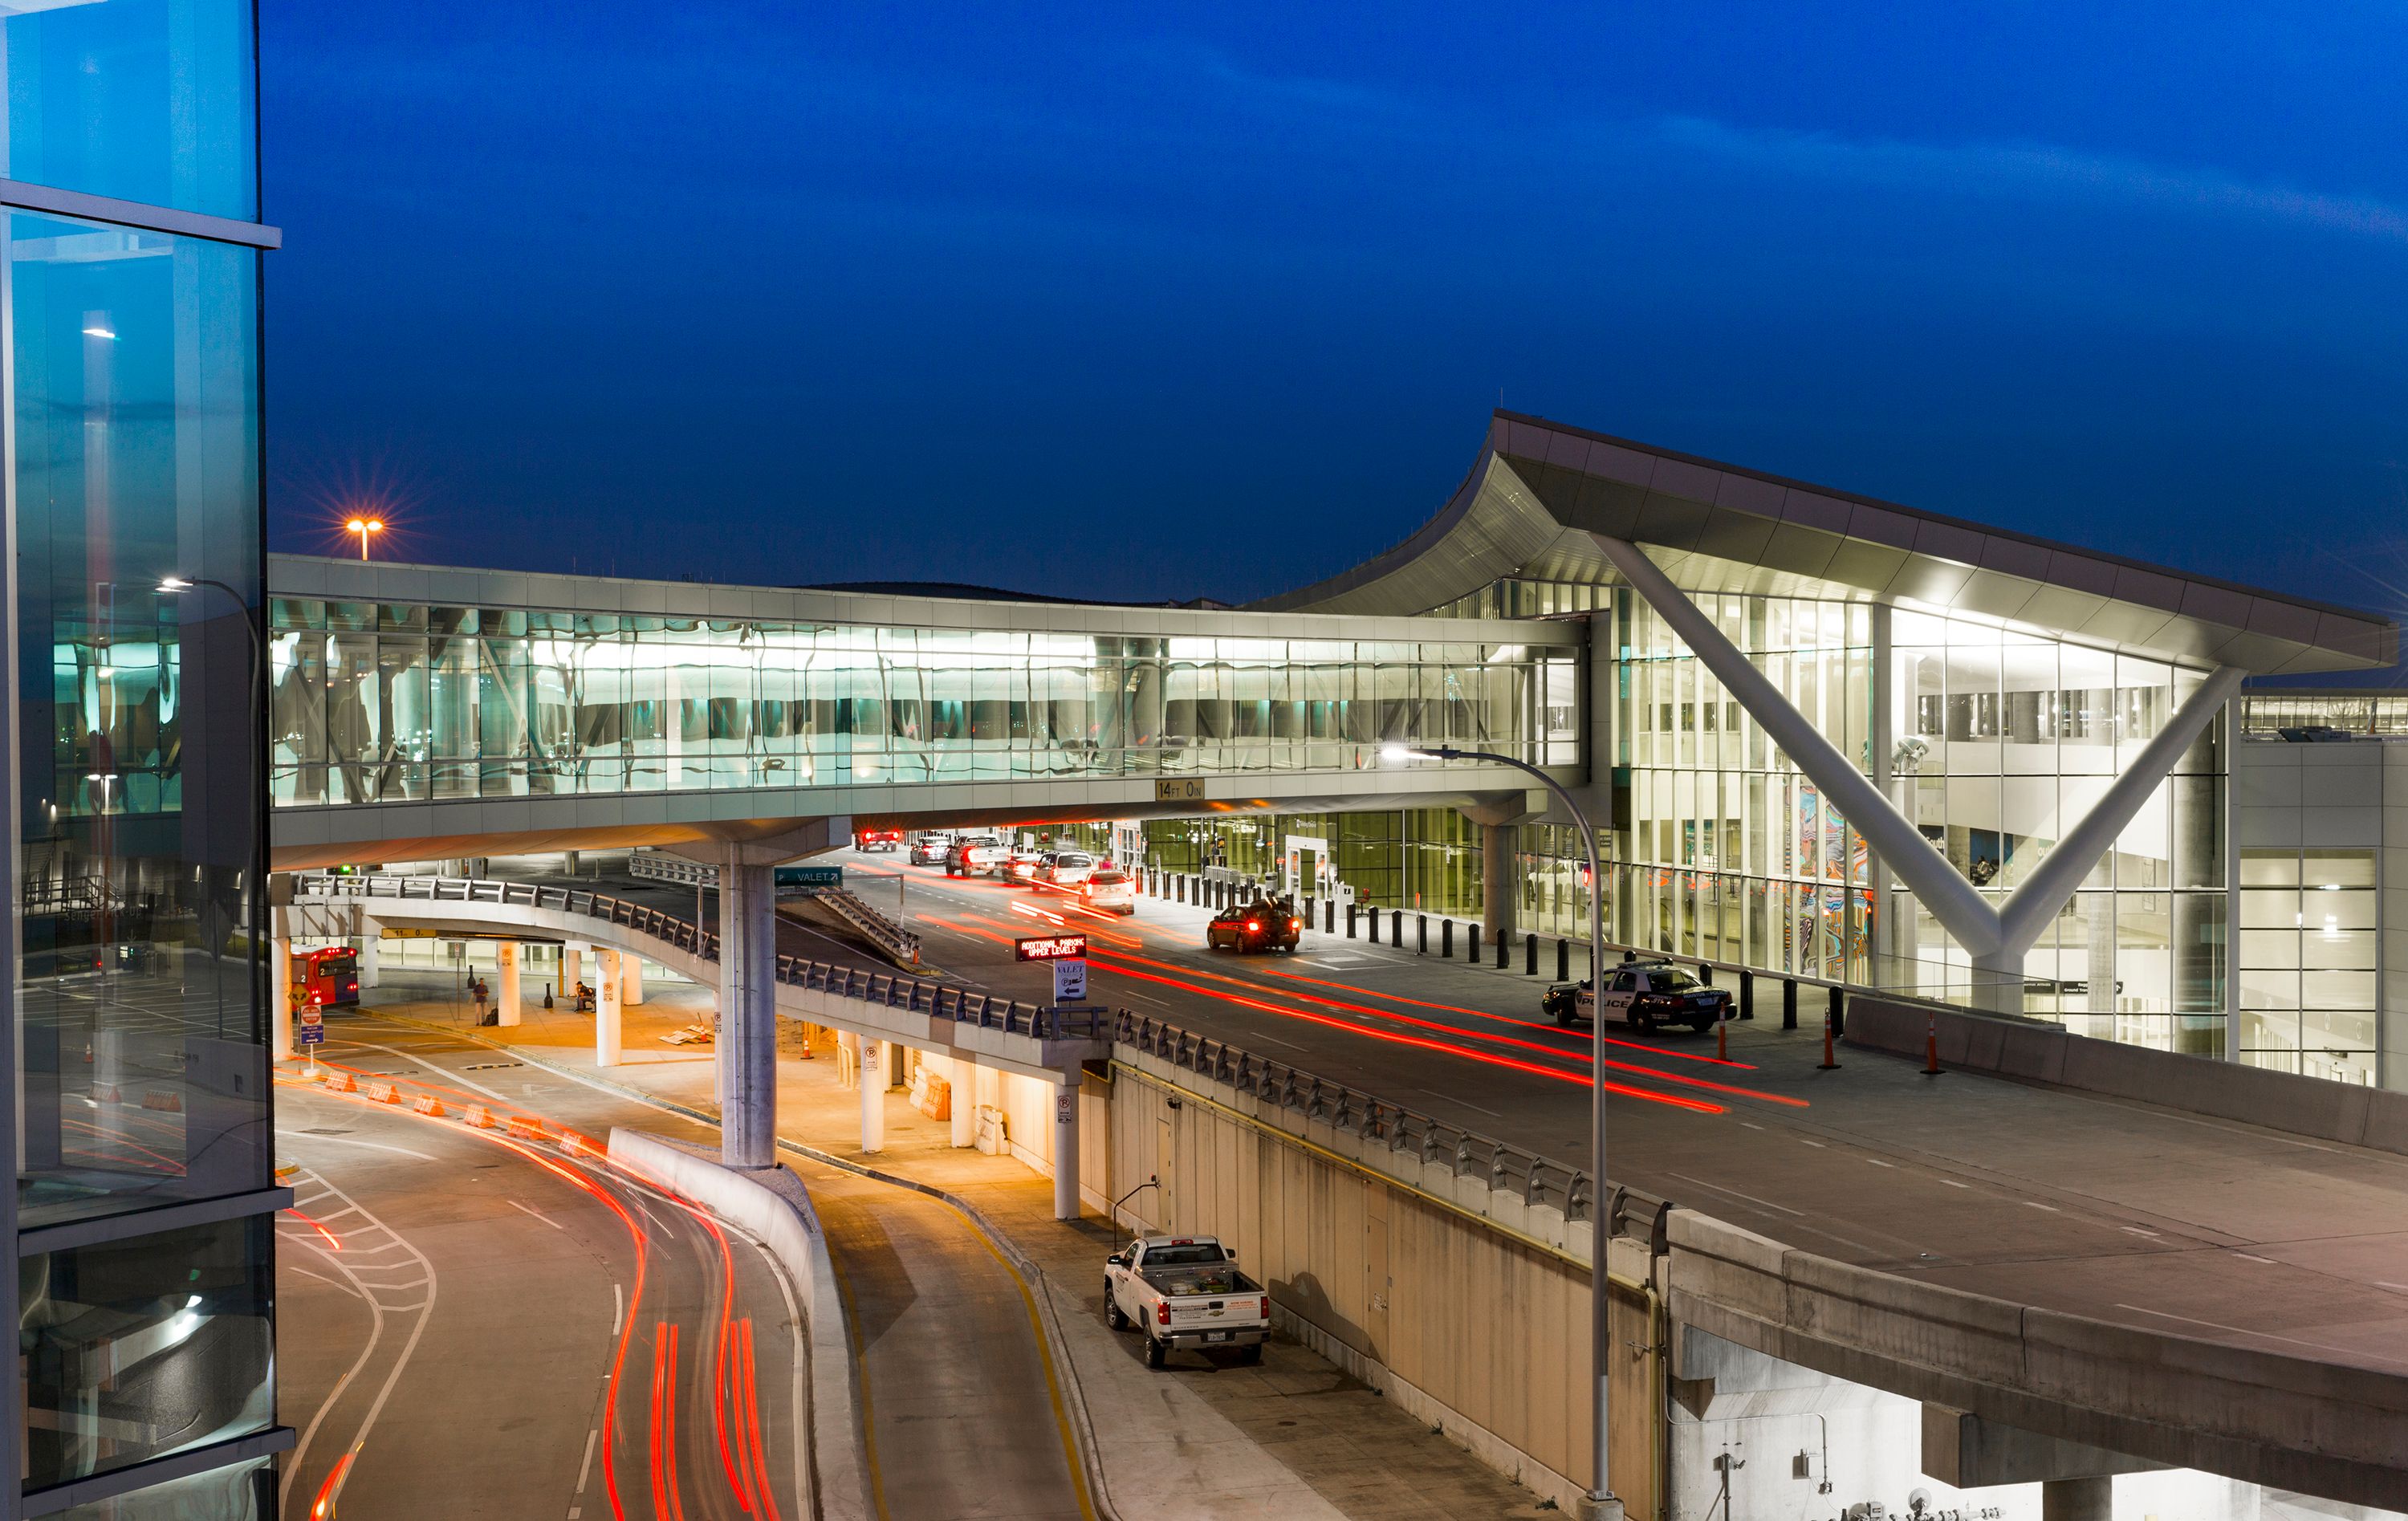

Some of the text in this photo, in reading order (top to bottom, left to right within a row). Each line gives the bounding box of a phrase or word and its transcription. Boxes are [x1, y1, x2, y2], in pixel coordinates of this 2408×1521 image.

[797, 872, 828, 881] VALET
[1021, 938, 1084, 950] ADDITIONAL PARKING
[1028, 946, 1076, 957] UPPER LEVELS
[320, 968, 325, 976] 2
[1057, 966, 1084, 974] VALET
